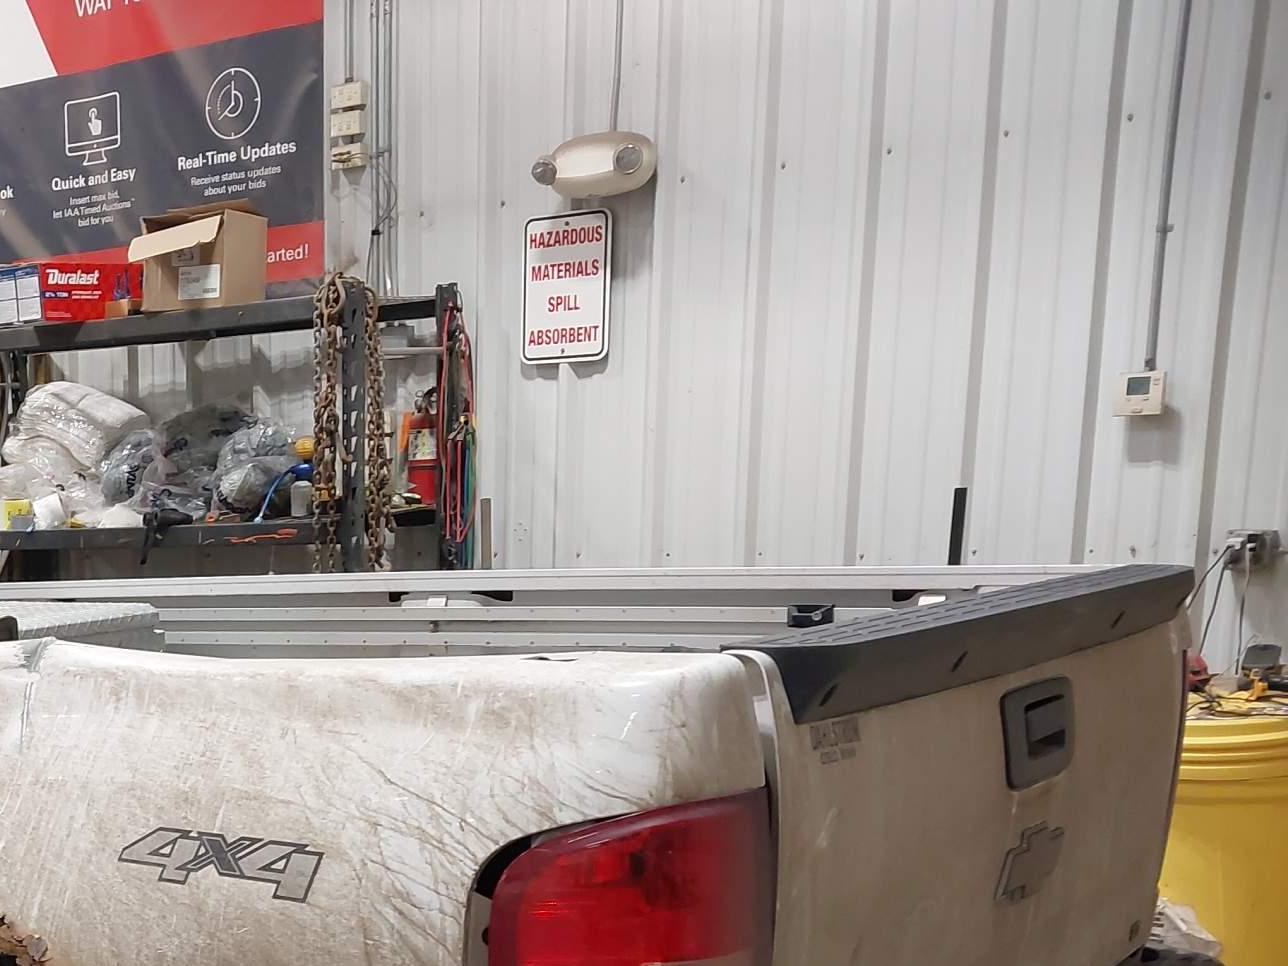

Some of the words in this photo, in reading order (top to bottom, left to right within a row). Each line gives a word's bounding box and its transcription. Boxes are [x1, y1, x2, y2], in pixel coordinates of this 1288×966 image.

[177, 151, 237, 171] Real-Time
[240, 141, 297, 162] Updates
[51, 174, 86, 191] Quick
[88, 170, 109, 186] and
[110, 168, 136, 182] Easy
[190, 174, 220, 186] Receive
[221, 171, 246, 182] status
[247, 165, 282, 178] updates
[203, 185, 226, 197] about
[227, 182, 247, 194] your
[248, 179, 266, 190] bids
[69, 195, 90, 205] Insert
[53, 210, 63, 219] let
[64, 207, 80, 217] IAA
[80, 204, 101, 215] Timed
[78, 218, 90, 227] bid
[90, 216, 100, 225] for
[529, 225, 603, 249] HAZARDOUS
[267, 243, 309, 263] arted!
[45, 268, 99, 285] Duralast
[531, 259, 600, 282] MATERIALS
[547, 294, 580, 313] SPILL
[528, 325, 600, 346] ABSORBENT
